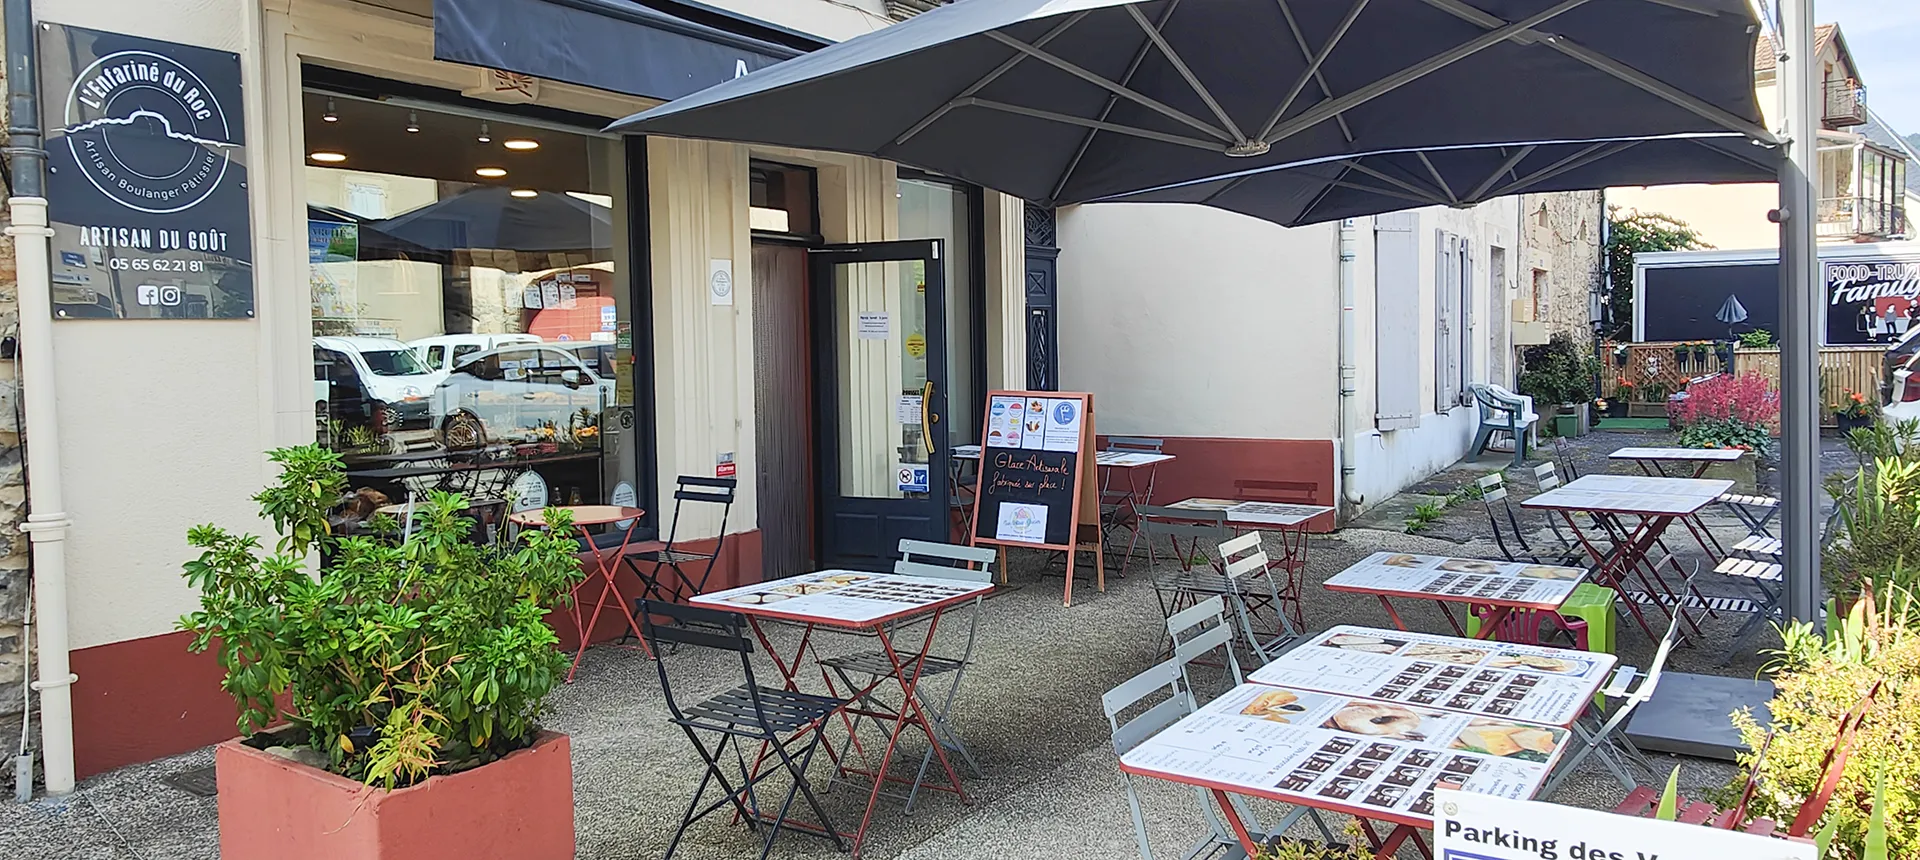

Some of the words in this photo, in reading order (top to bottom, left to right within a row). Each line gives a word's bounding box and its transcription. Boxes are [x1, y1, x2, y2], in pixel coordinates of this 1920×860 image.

[79, 60, 159, 110] L'Enfariné
[163, 70, 186, 94] du
[183, 86, 212, 122] Roc
[83, 138, 118, 183] Artisan
[118, 177, 181, 201] Boulanger
[182, 150, 217, 194] Pâtissier
[80, 226, 151, 248] ARTISAN
[160, 229, 181, 249] DU
[188, 229, 228, 252] GOÛT
[110, 257, 130, 271] 05
[132, 257, 150, 271] 65
[152, 258, 171, 272] 62
[172, 259, 187, 272] 21
[189, 260, 205, 273] 81
[995, 452, 1025, 469] Glace
[1026, 454, 1070, 475] Artisanale
[1038, 474, 1058, 496] place
[1445, 819, 1558, 860] Parking
[1569, 842, 1624, 860] des
